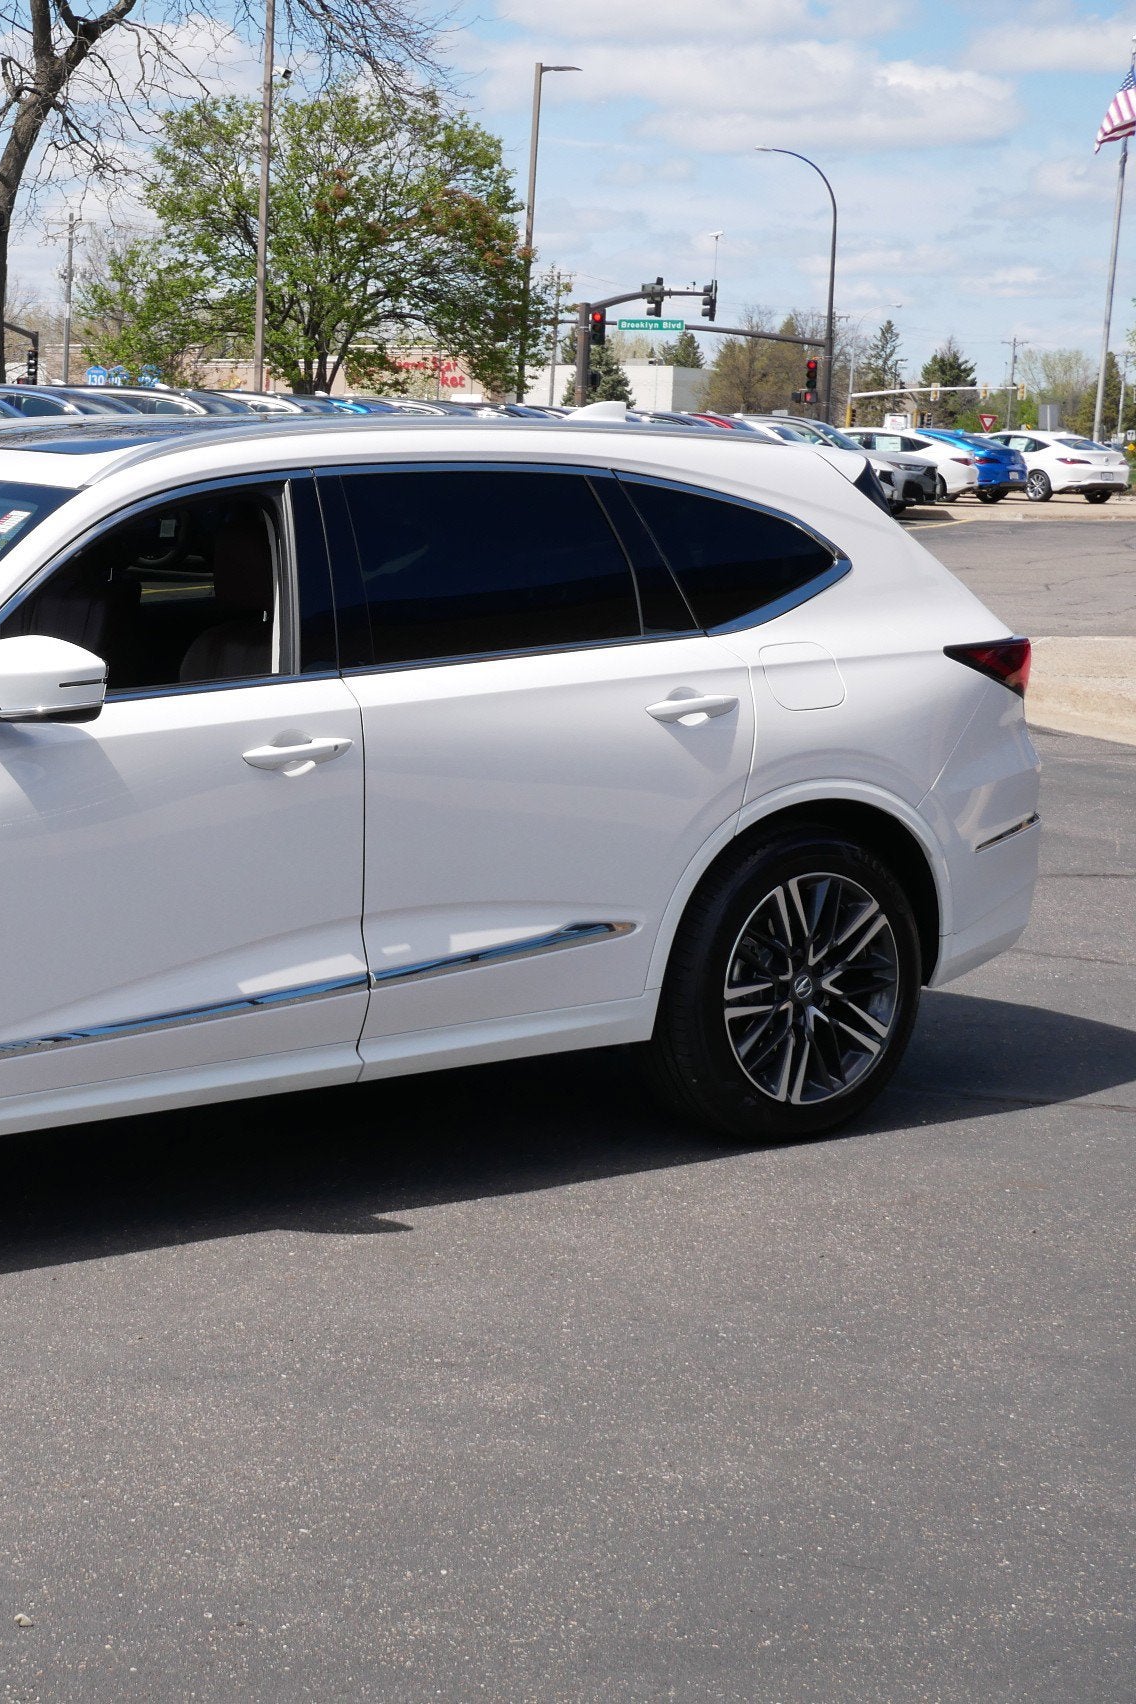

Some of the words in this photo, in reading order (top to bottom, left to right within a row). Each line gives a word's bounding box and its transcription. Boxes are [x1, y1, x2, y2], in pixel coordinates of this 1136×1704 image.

[621, 321, 659, 330] Brooklyn
[662, 321, 682, 329] Blvd
[88, 374, 105, 386] 130
